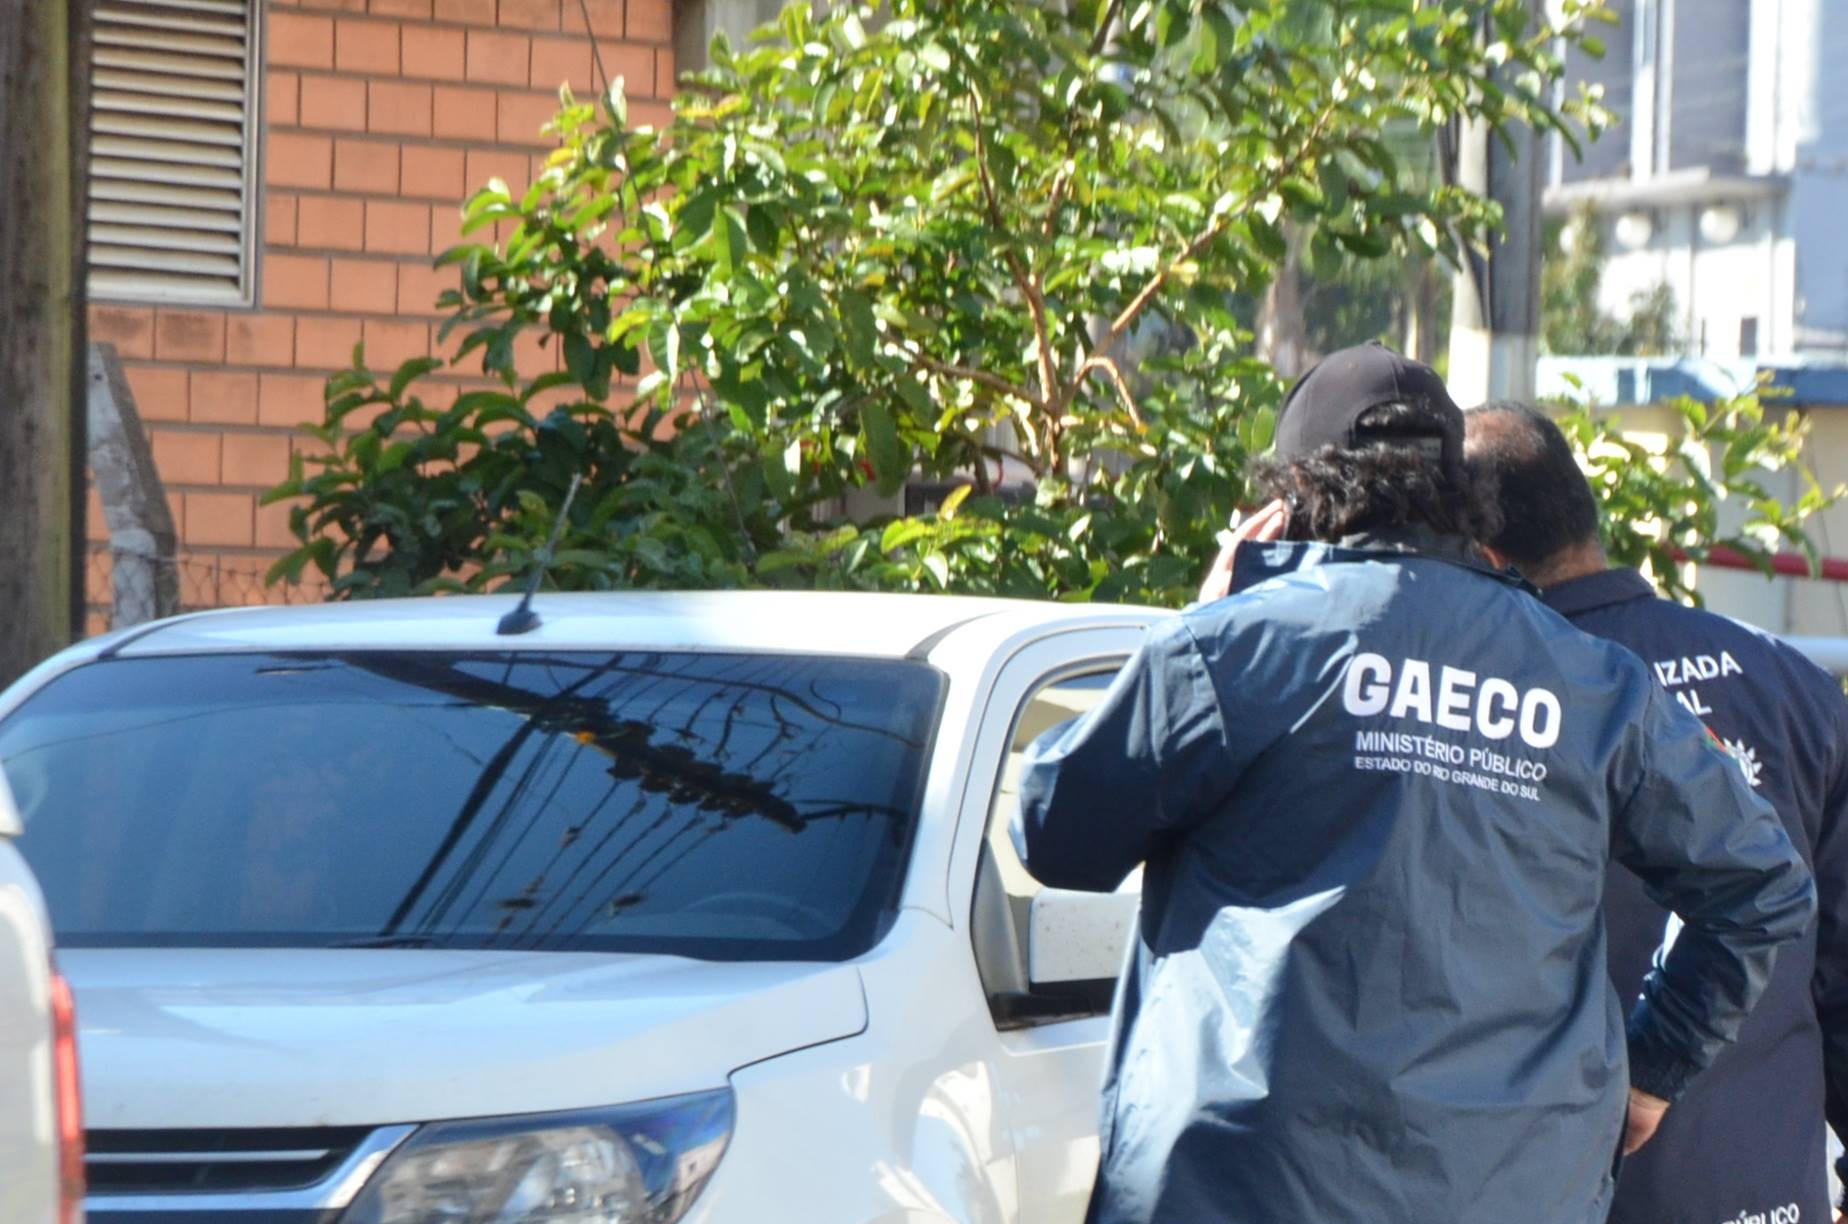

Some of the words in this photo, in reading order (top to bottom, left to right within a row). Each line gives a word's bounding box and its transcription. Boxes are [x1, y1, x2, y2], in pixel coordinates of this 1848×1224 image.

[1343, 652, 1562, 749] GAECO
[1355, 731, 1465, 765] MINISTÉRIO
[1469, 748, 1547, 782] PÚBLICO
[1355, 756, 1411, 772] ESTADO
[1414, 760, 1431, 776] DO
[1433, 765, 1450, 781] RIO
[1452, 770, 1499, 792] GRANDE
[1501, 782, 1518, 797] DO
[1520, 786, 1541, 801] SUL
